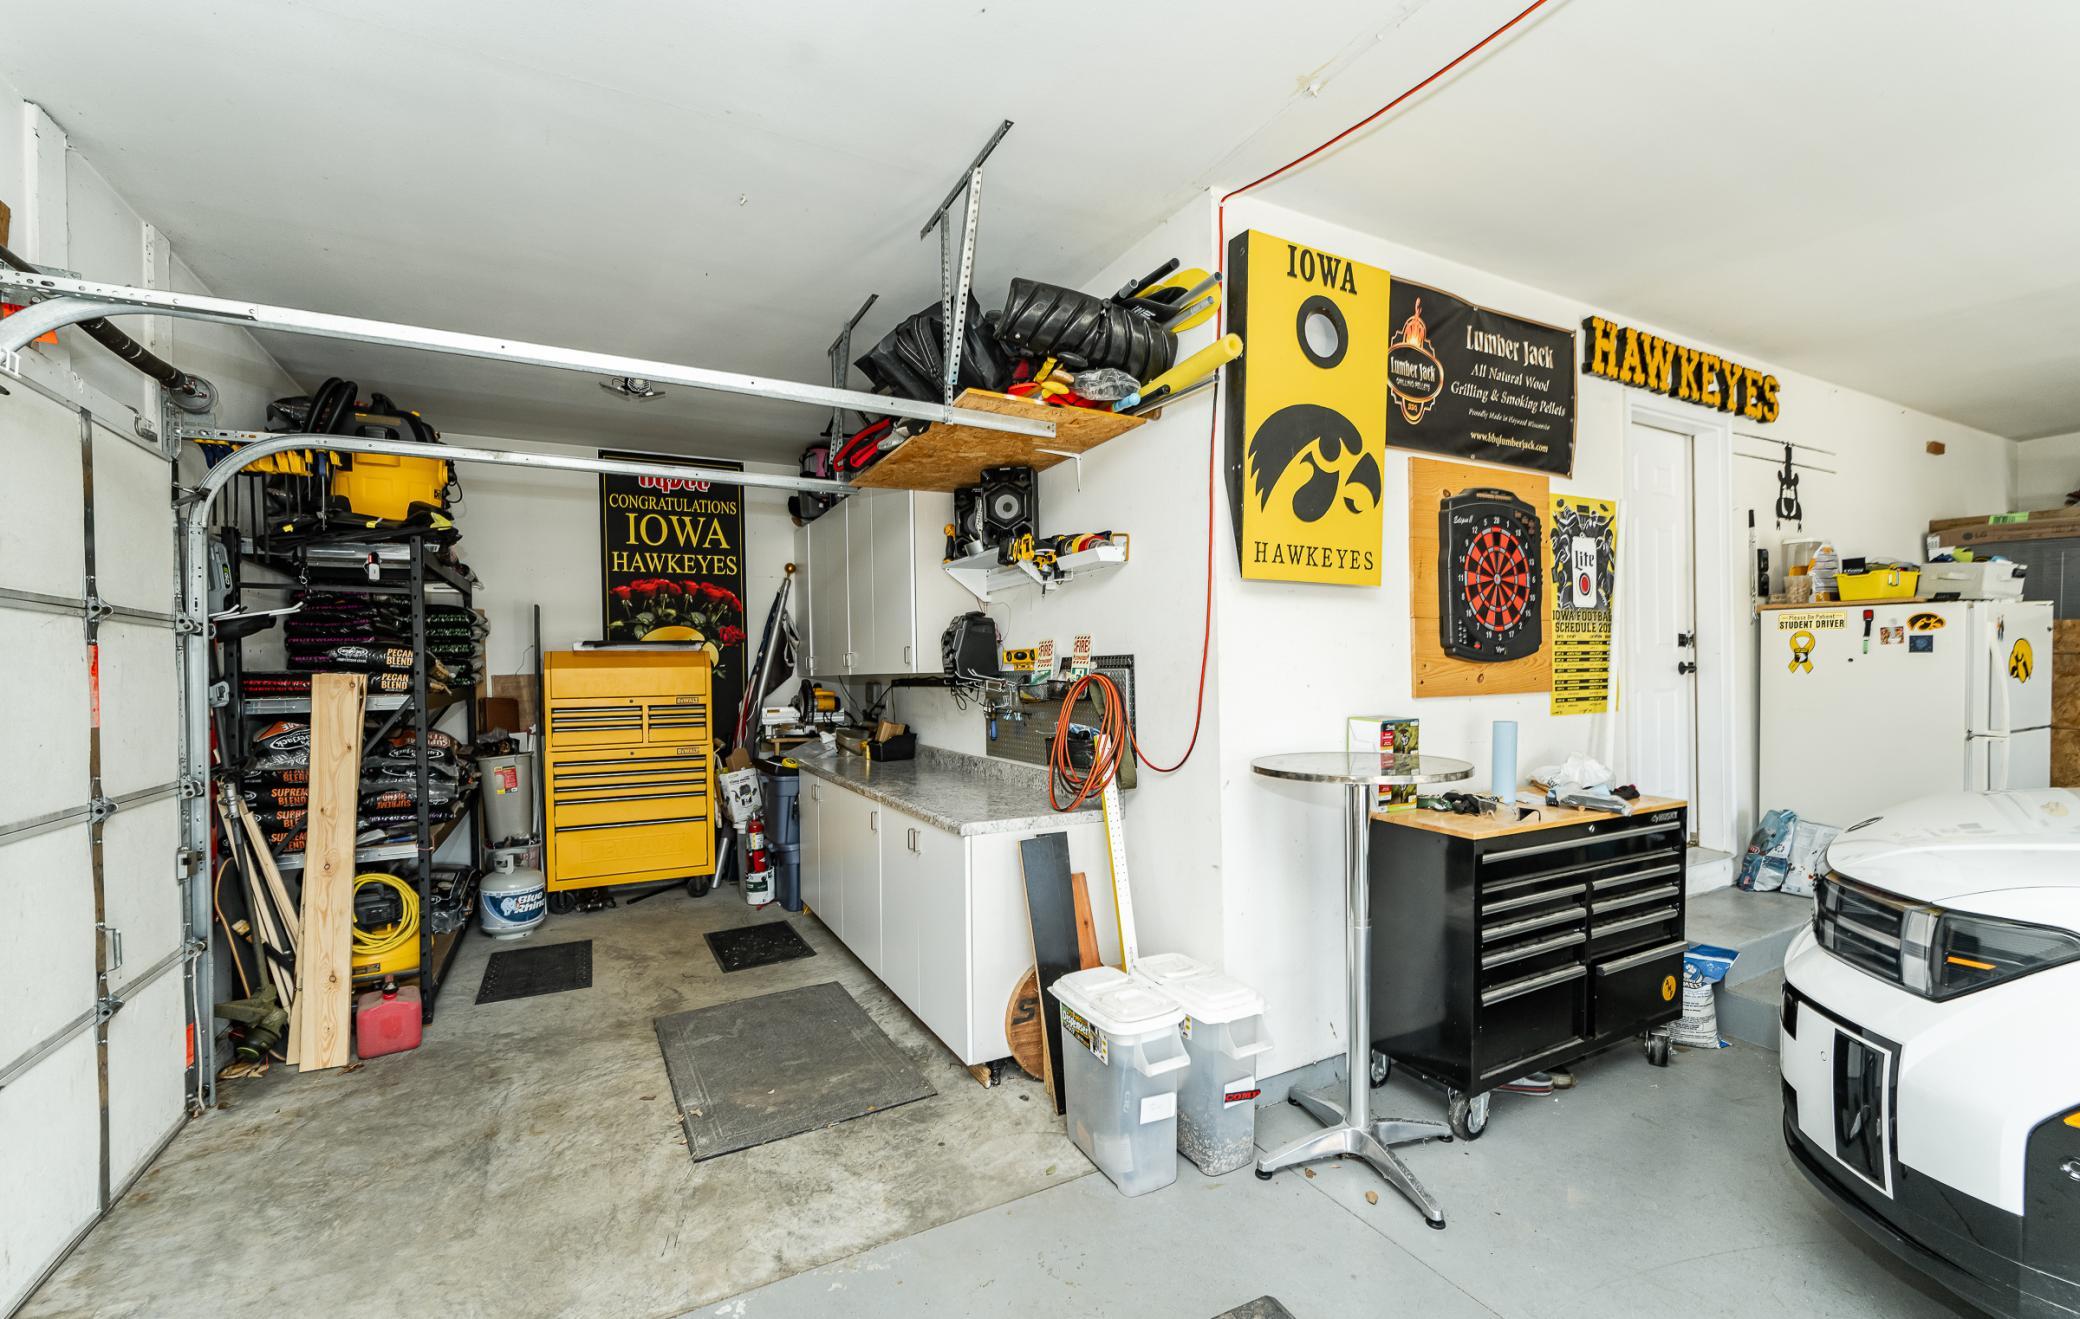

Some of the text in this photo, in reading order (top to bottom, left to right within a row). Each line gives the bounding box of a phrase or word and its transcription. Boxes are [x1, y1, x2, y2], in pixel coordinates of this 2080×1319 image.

[1287, 244, 1357, 295] IOWA
[1466, 325, 1554, 369] Lumber Jack
[1391, 356, 1436, 382] Lumber Jack
[1583, 315, 1780, 423] HAWKEYES
[1471, 363, 1550, 392] All Natural Wood
[1451, 381, 1566, 417] Grilling & Smoking Pellets
[1468, 408, 1488, 420] Proudly
[1489, 412, 1502, 421] Made
[1470, 431, 1549, 453] www.bbqlumberjack.com
[609, 493, 737, 515] CONGRATULATIONS
[625, 513, 731, 549] IOWA
[1254, 541, 1374, 571] HAWKEYES
[1459, 555, 1465, 563] 14
[1575, 550, 1595, 571] Lite
[612, 552, 738, 575] HAWKEYES
[1458, 574, 1464, 582] 11
[1552, 610, 1612, 622] IOWA FOOTBAL
[1555, 622, 1611, 633] SCHEDULE 201
[1779, 619, 1845, 629] STUDENT DRIVER
[387, 648, 414, 657] PECAN
[1075, 639, 1090, 653] FIRE
[386, 656, 414, 666] BLEND
[382, 673, 409, 682] PECAN
[381, 681, 408, 690] BLEND
[271, 788, 309, 798] SUPREM
[278, 797, 306, 806] BLEND
[517, 892, 543, 904] Blue
